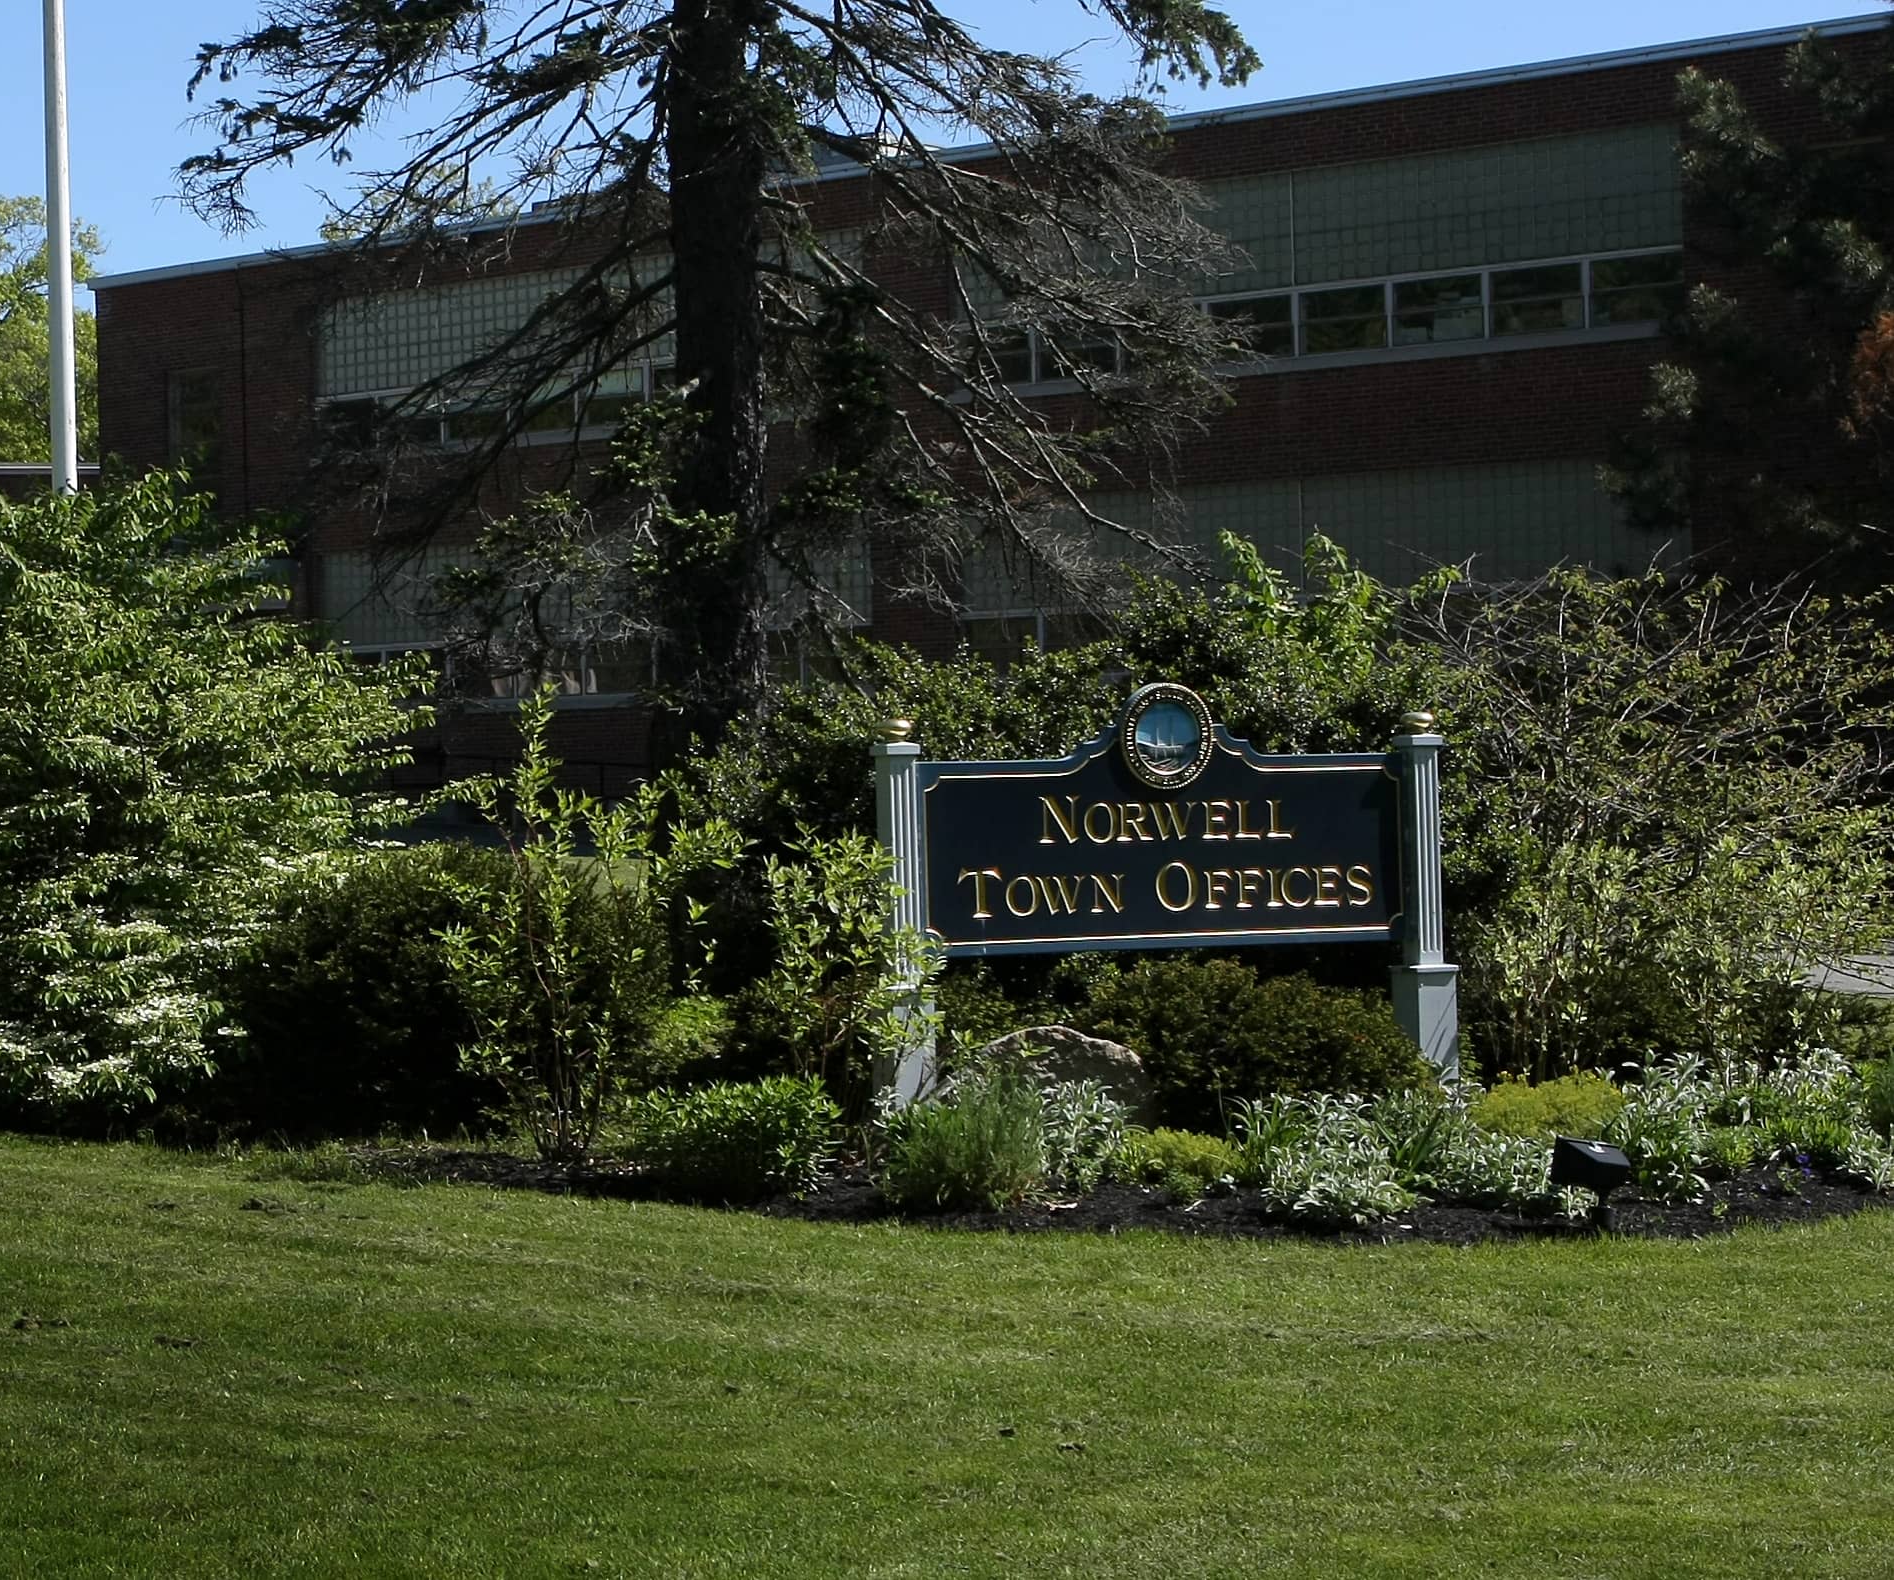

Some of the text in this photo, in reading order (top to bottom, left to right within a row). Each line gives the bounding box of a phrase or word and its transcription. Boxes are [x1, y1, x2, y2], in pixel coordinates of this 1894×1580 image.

[1038, 795, 1295, 844] NORWELL
[957, 861, 1373, 919] TOWN OFFICES
